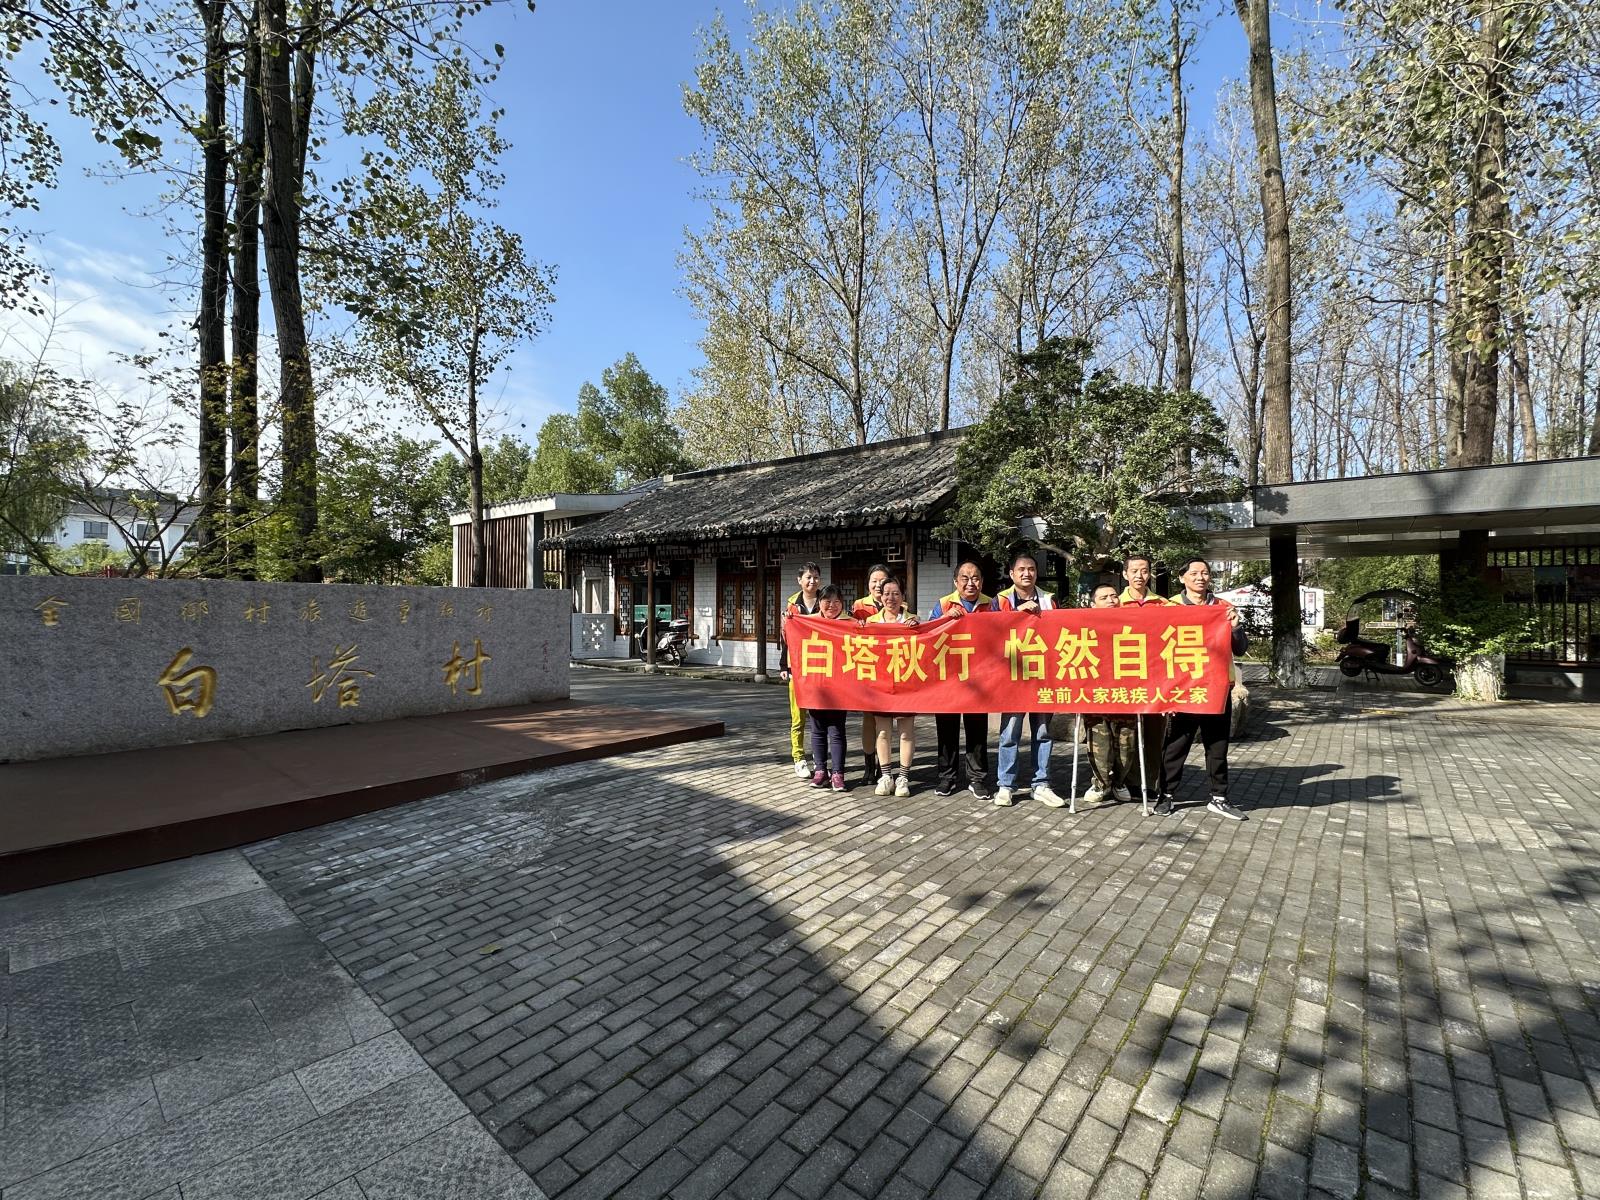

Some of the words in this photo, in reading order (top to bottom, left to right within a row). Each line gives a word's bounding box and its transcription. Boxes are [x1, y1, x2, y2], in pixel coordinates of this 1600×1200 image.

[156, 636, 492, 718] 白塔村
[801, 631, 976, 683] 白塔秋行
[1004, 624, 1210, 681] 怡然自得
[1037, 686, 1209, 704] 堂前人家残疾人之家
